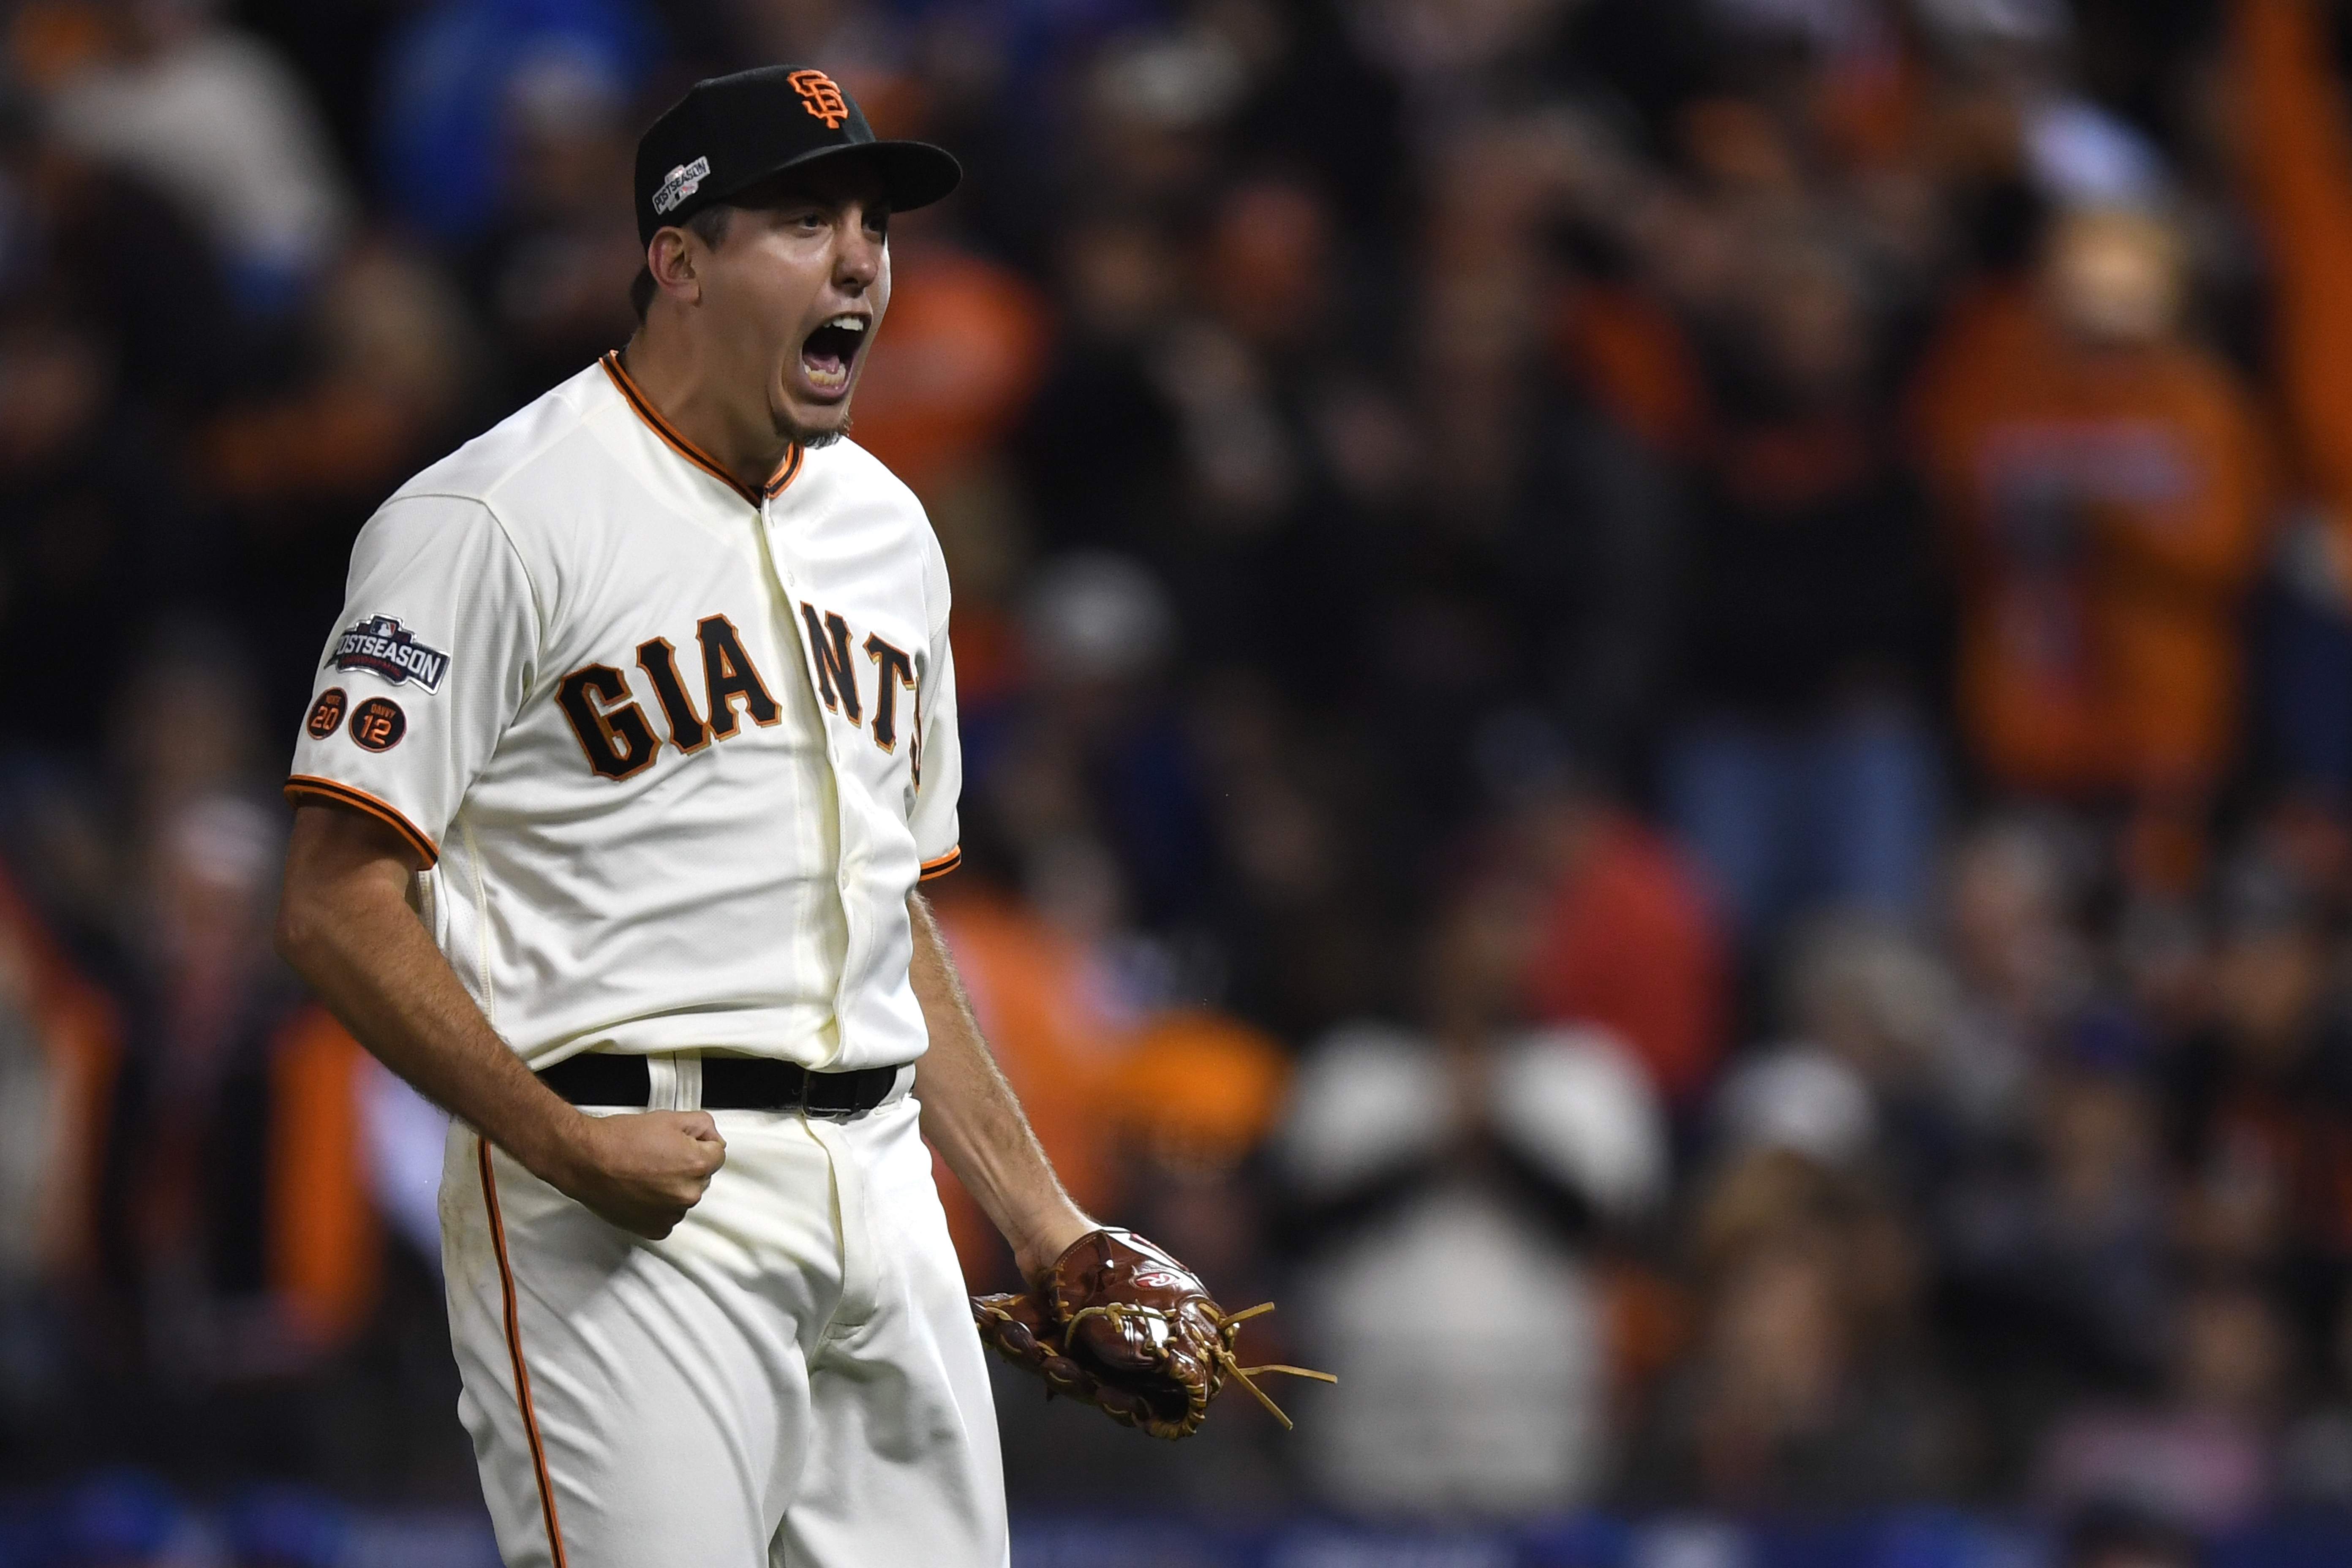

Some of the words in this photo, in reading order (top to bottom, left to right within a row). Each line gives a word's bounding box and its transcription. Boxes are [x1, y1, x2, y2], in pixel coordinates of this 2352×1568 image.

[787, 69, 848, 129] SF
[655, 160, 707, 212] POSTSEASON
[336, 634, 441, 683] OSTSEASON
[311, 705, 339, 730] 20
[554, 600, 923, 798] GIANT
[360, 715, 392, 745] 12
